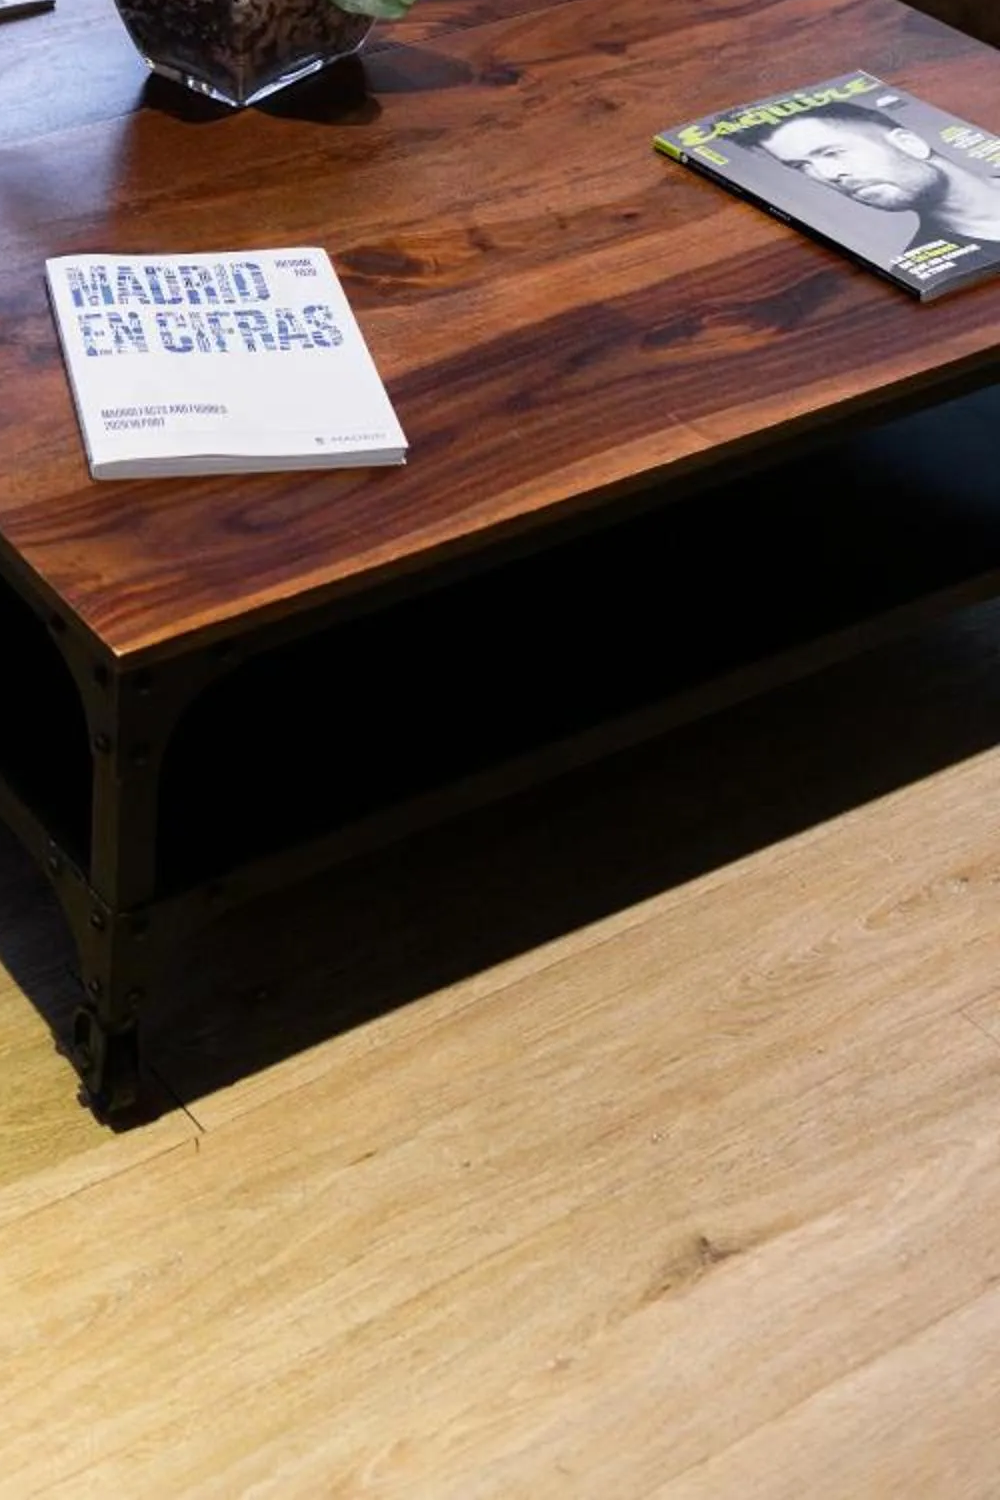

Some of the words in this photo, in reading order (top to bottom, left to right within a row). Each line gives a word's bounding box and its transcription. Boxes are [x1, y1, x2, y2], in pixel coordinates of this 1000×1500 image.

[677, 78, 880, 146] Esquire
[66, 261, 271, 308] MADRID
[77, 312, 149, 356] EN
[155, 305, 345, 353] CIFRAS
